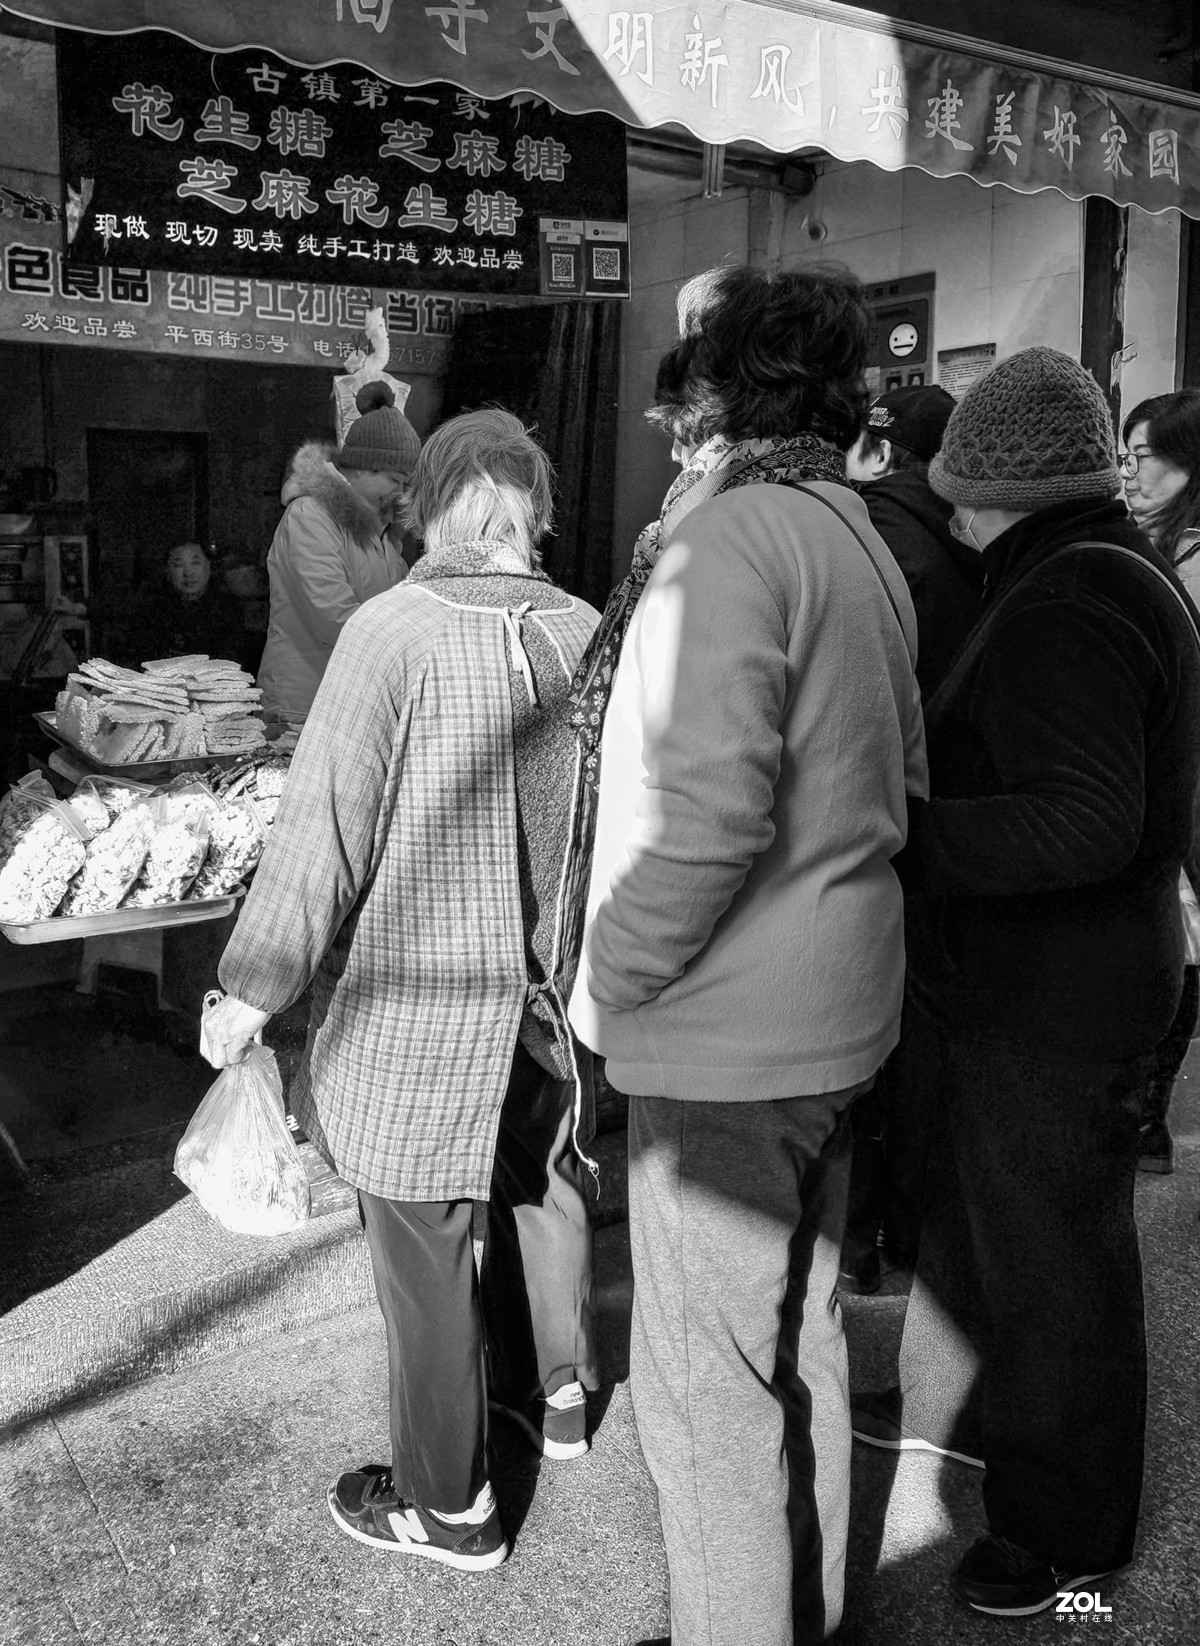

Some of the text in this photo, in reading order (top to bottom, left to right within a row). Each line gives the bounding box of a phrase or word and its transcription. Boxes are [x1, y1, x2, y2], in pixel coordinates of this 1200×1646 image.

[246, 62, 490, 120] 古镇第一家
[112, 82, 572, 182] 花生糖 芝麻糖
[177, 156, 523, 236] 芝麻花生糖
[94, 214, 524, 270] 现做 现切 现卖 纯手工打造 欢迎品尝
[22, 311, 137, 339] 欢迎品尝
[165, 325, 289, 353] 平西街35号
